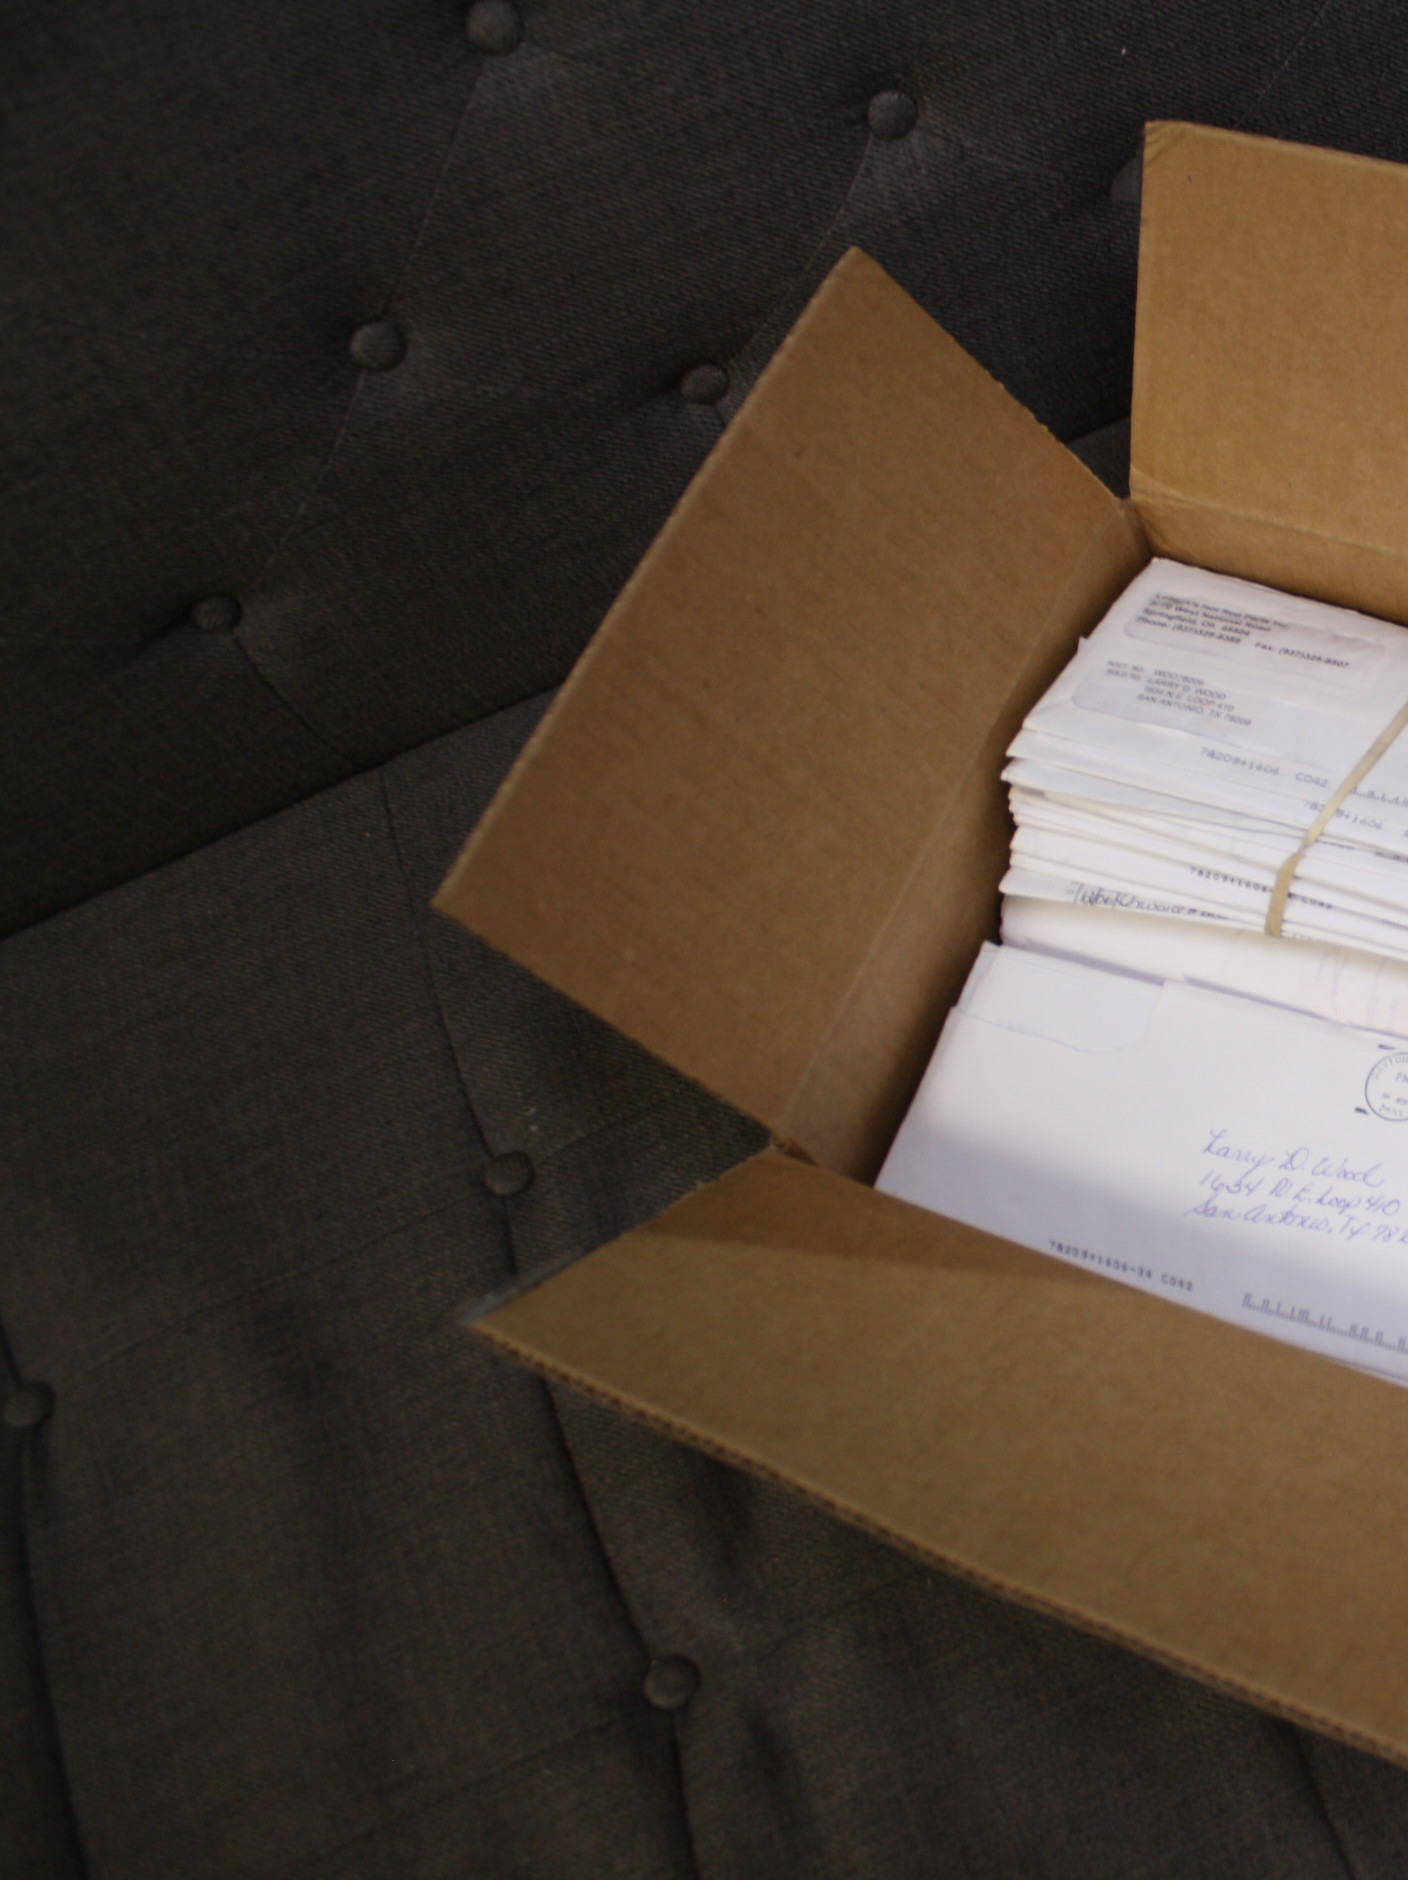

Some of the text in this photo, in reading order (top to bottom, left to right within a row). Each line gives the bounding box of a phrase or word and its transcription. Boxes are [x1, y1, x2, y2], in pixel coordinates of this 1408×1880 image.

[1136, 693, 1156, 704] SAN
[1146, 677, 1179, 690] LARRY
[1195, 687, 1228, 700] WOOD
[1187, 694, 1216, 706] LOOP
[1200, 746, 1280, 777] 78209+1606
[1302, 800, 1385, 831] 7829+1606
[1202, 1128, 1274, 1178] Larry
[1311, 1157, 1384, 1188] Wood
[1182, 1193, 1243, 1221] San
[1200, 1169, 1264, 1196] 1634
[1315, 1185, 1362, 1215] Loop
[1364, 1195, 1401, 1217] 410
[1049, 1239, 1153, 1280] 78209+1606-34
